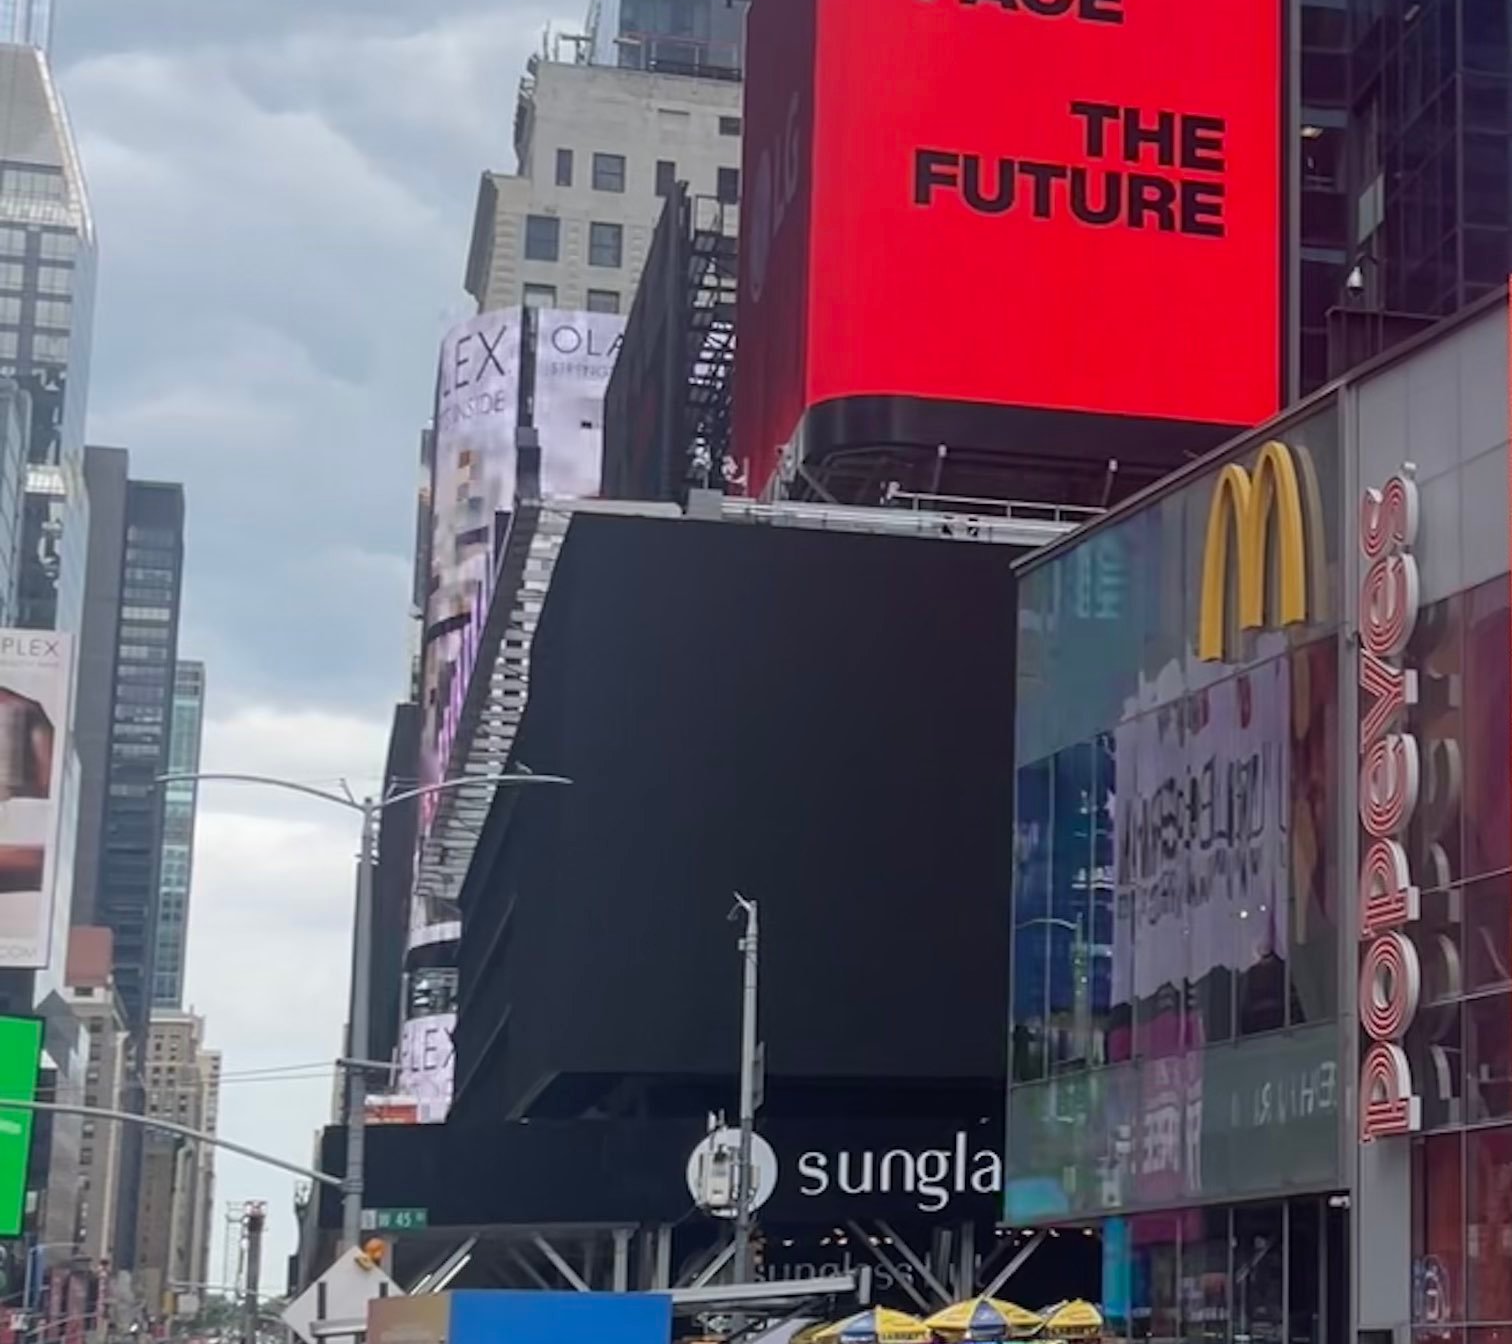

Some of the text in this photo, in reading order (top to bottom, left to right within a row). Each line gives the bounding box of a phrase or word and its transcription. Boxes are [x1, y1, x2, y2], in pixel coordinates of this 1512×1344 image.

[1069, 100, 1226, 173] THE
[913, 147, 1226, 238] FUTURE
[396, 1212, 412, 1228] 45
